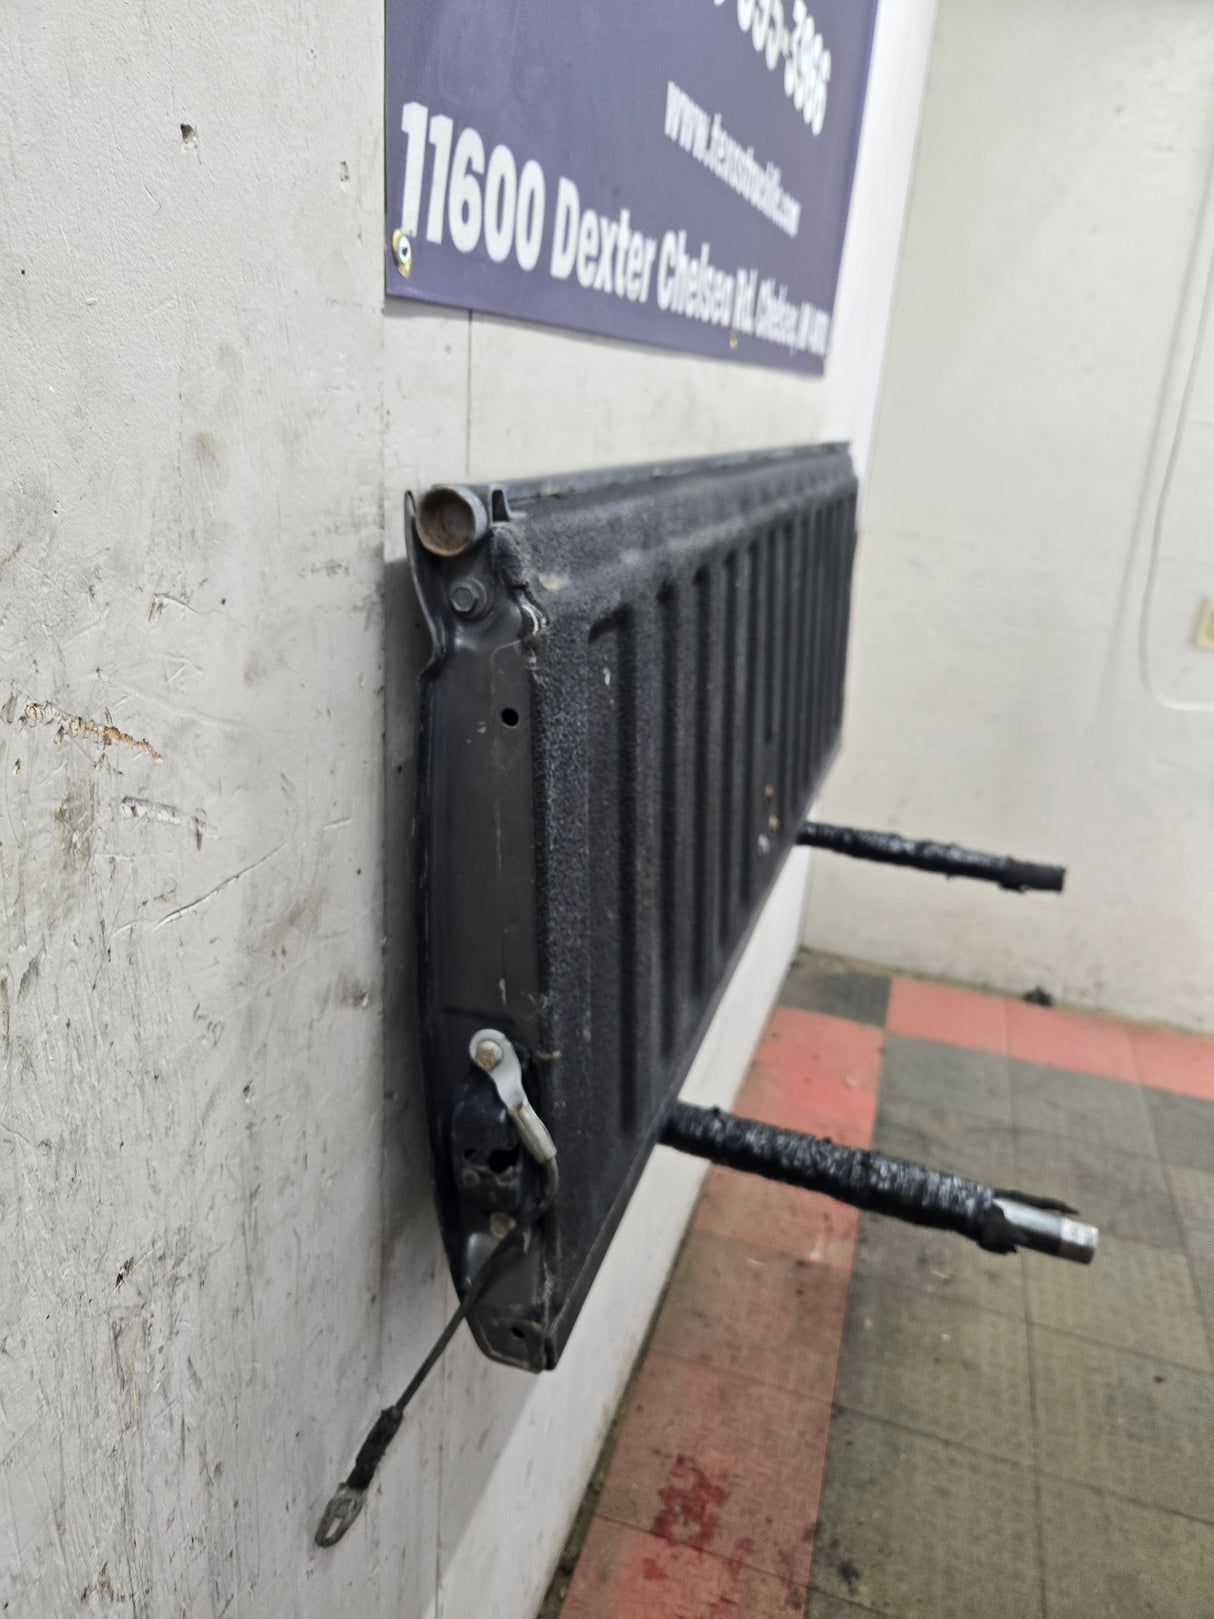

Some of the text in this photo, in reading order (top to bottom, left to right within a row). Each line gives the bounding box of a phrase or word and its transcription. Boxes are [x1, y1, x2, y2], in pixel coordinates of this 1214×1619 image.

[401, 101, 546, 271] 11600
[550, 176, 658, 304] Dexter
[656, 229, 735, 328] Chelsea
